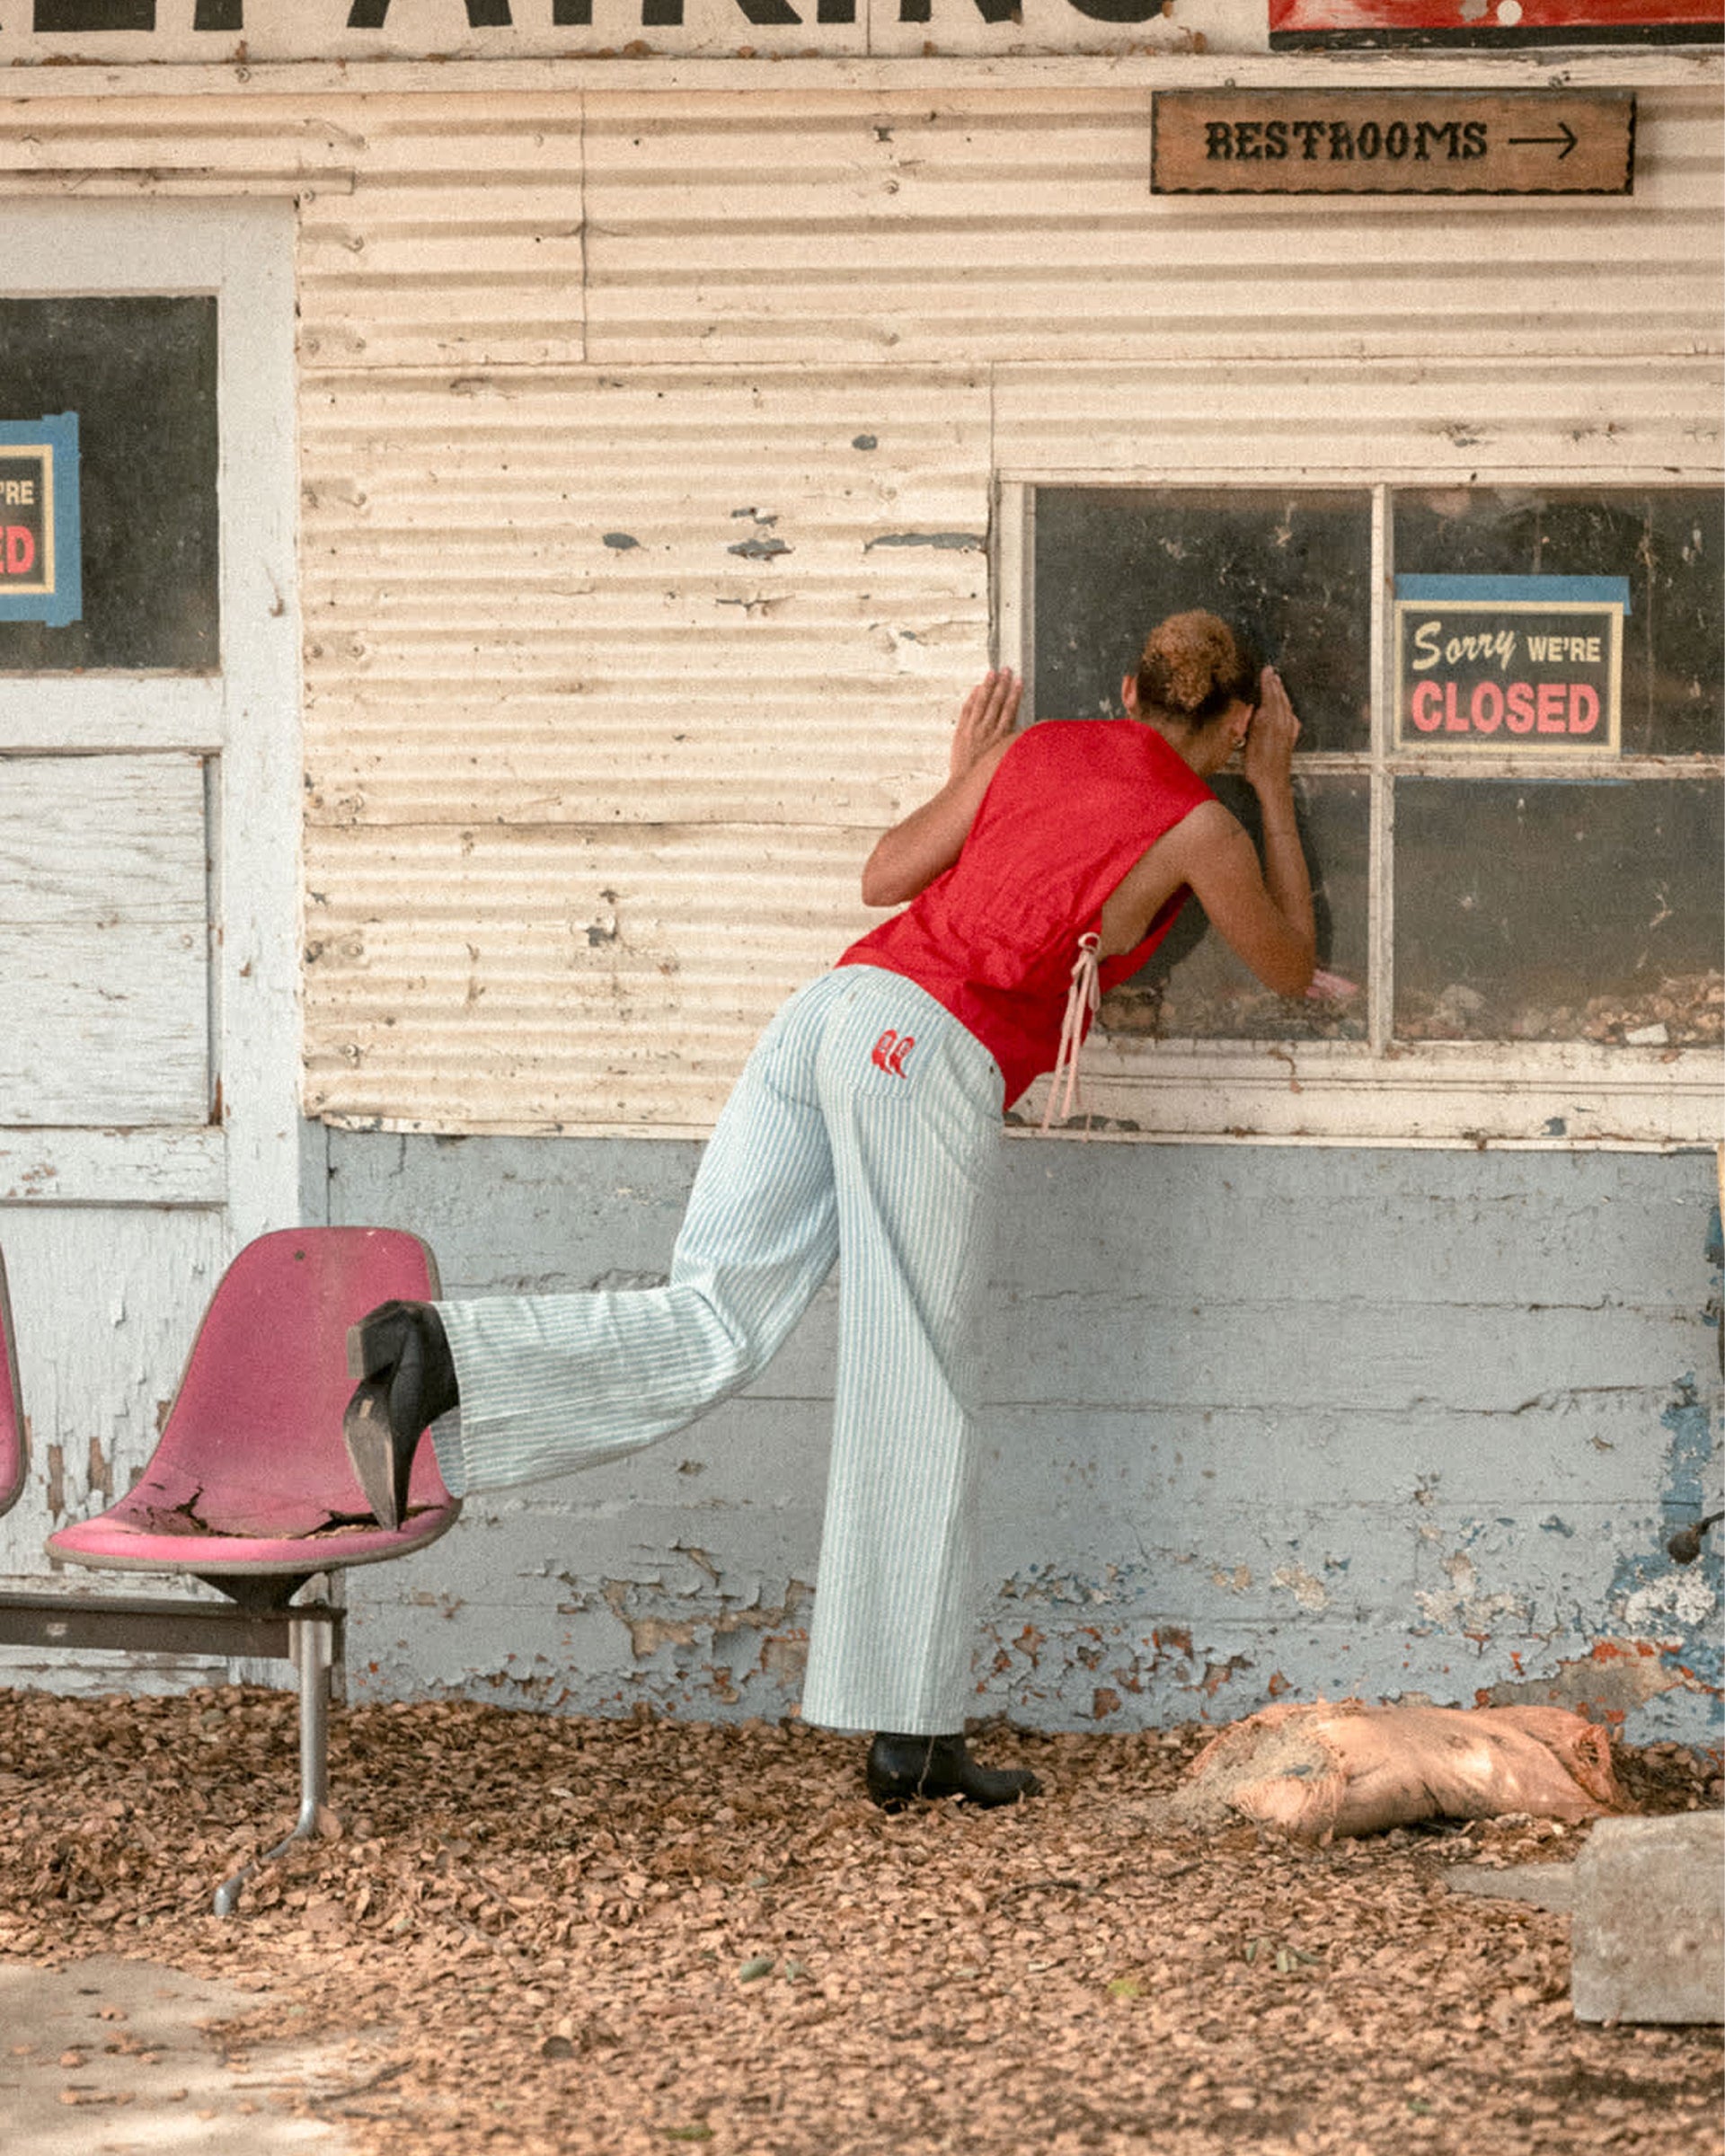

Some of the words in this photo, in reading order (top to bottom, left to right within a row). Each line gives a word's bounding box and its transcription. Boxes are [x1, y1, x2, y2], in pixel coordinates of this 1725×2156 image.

[1205, 120, 1488, 161] RESTROOMS
[1411, 621, 1517, 671] Sorry
[1527, 636, 1601, 663] WE'RE
[1411, 680, 1600, 735] CLOSED
